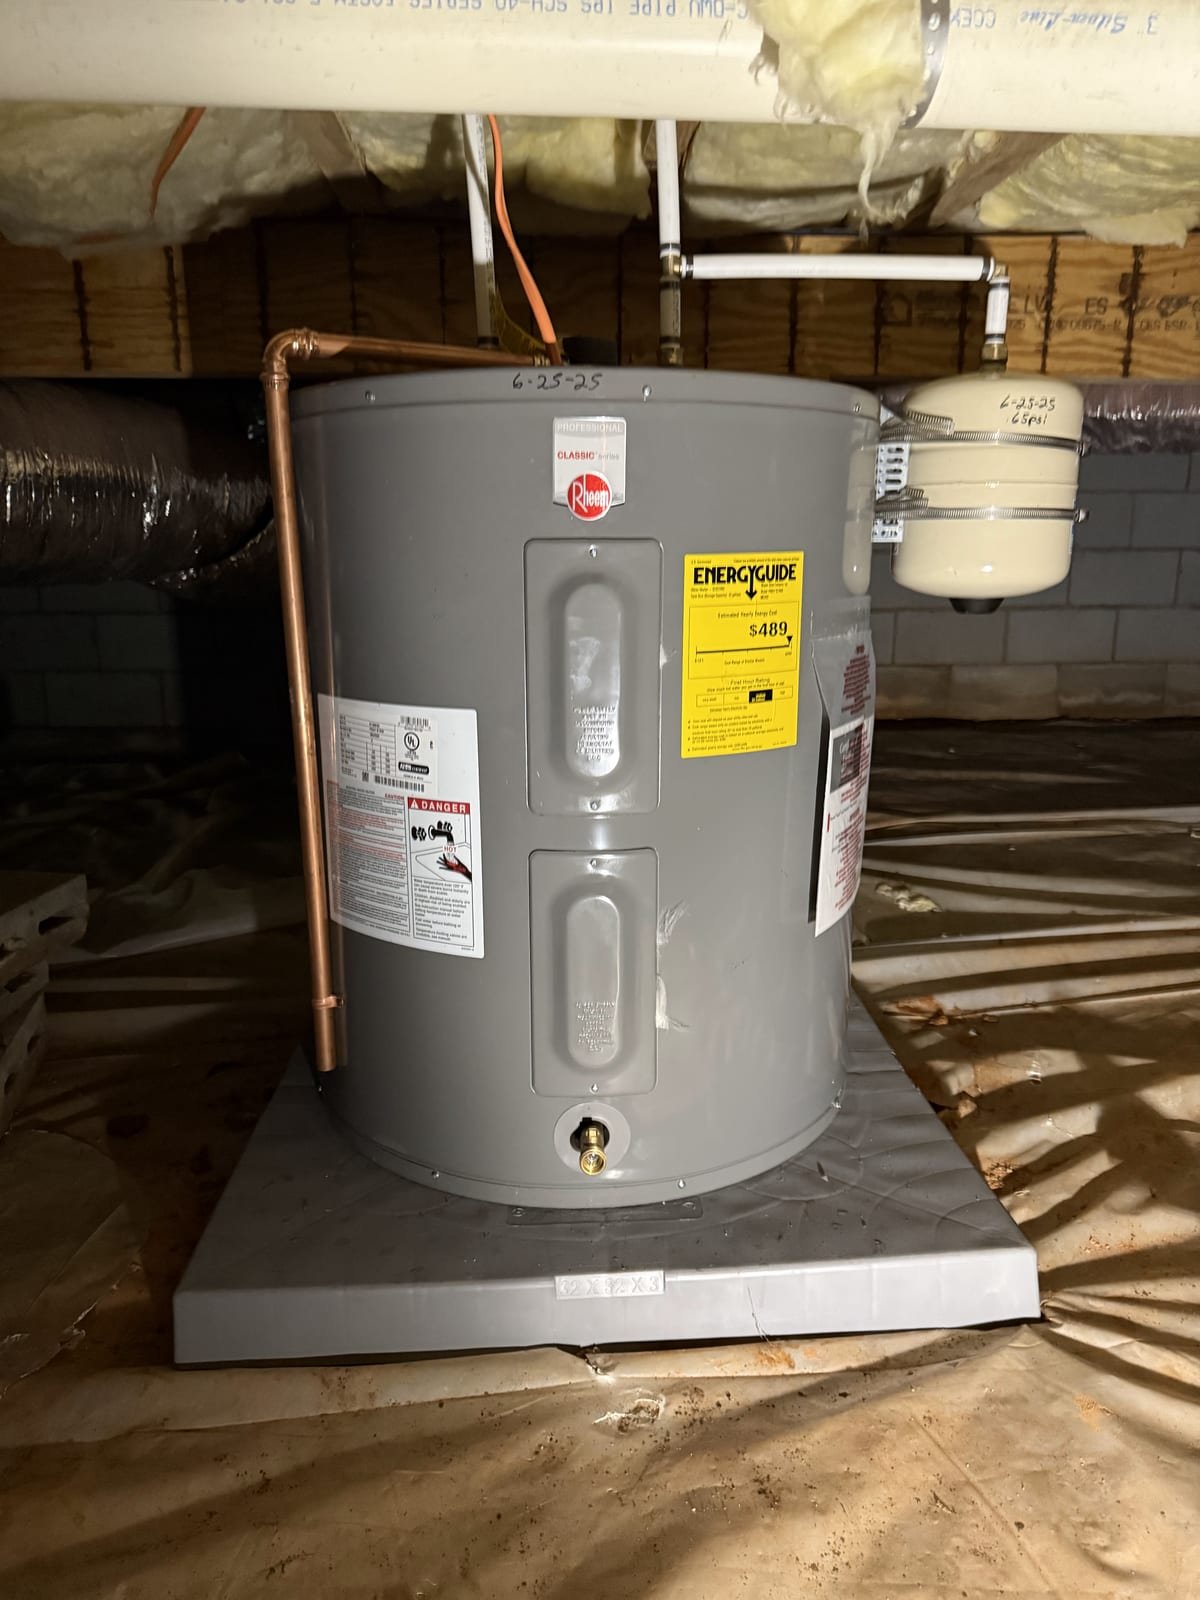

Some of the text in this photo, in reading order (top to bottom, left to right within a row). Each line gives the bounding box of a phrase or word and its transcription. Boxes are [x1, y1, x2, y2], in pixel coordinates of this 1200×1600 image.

[1019, 10, 1128, 34] Silver-Line
[512, 372, 602, 390] 6-25-25
[557, 451, 595, 460] CLASSIC
[572, 475, 609, 512] Rheem
[693, 563, 797, 585] ENERGYGUIDE
[749, 621, 788, 637] $489
[421, 800, 466, 814] DANGER
